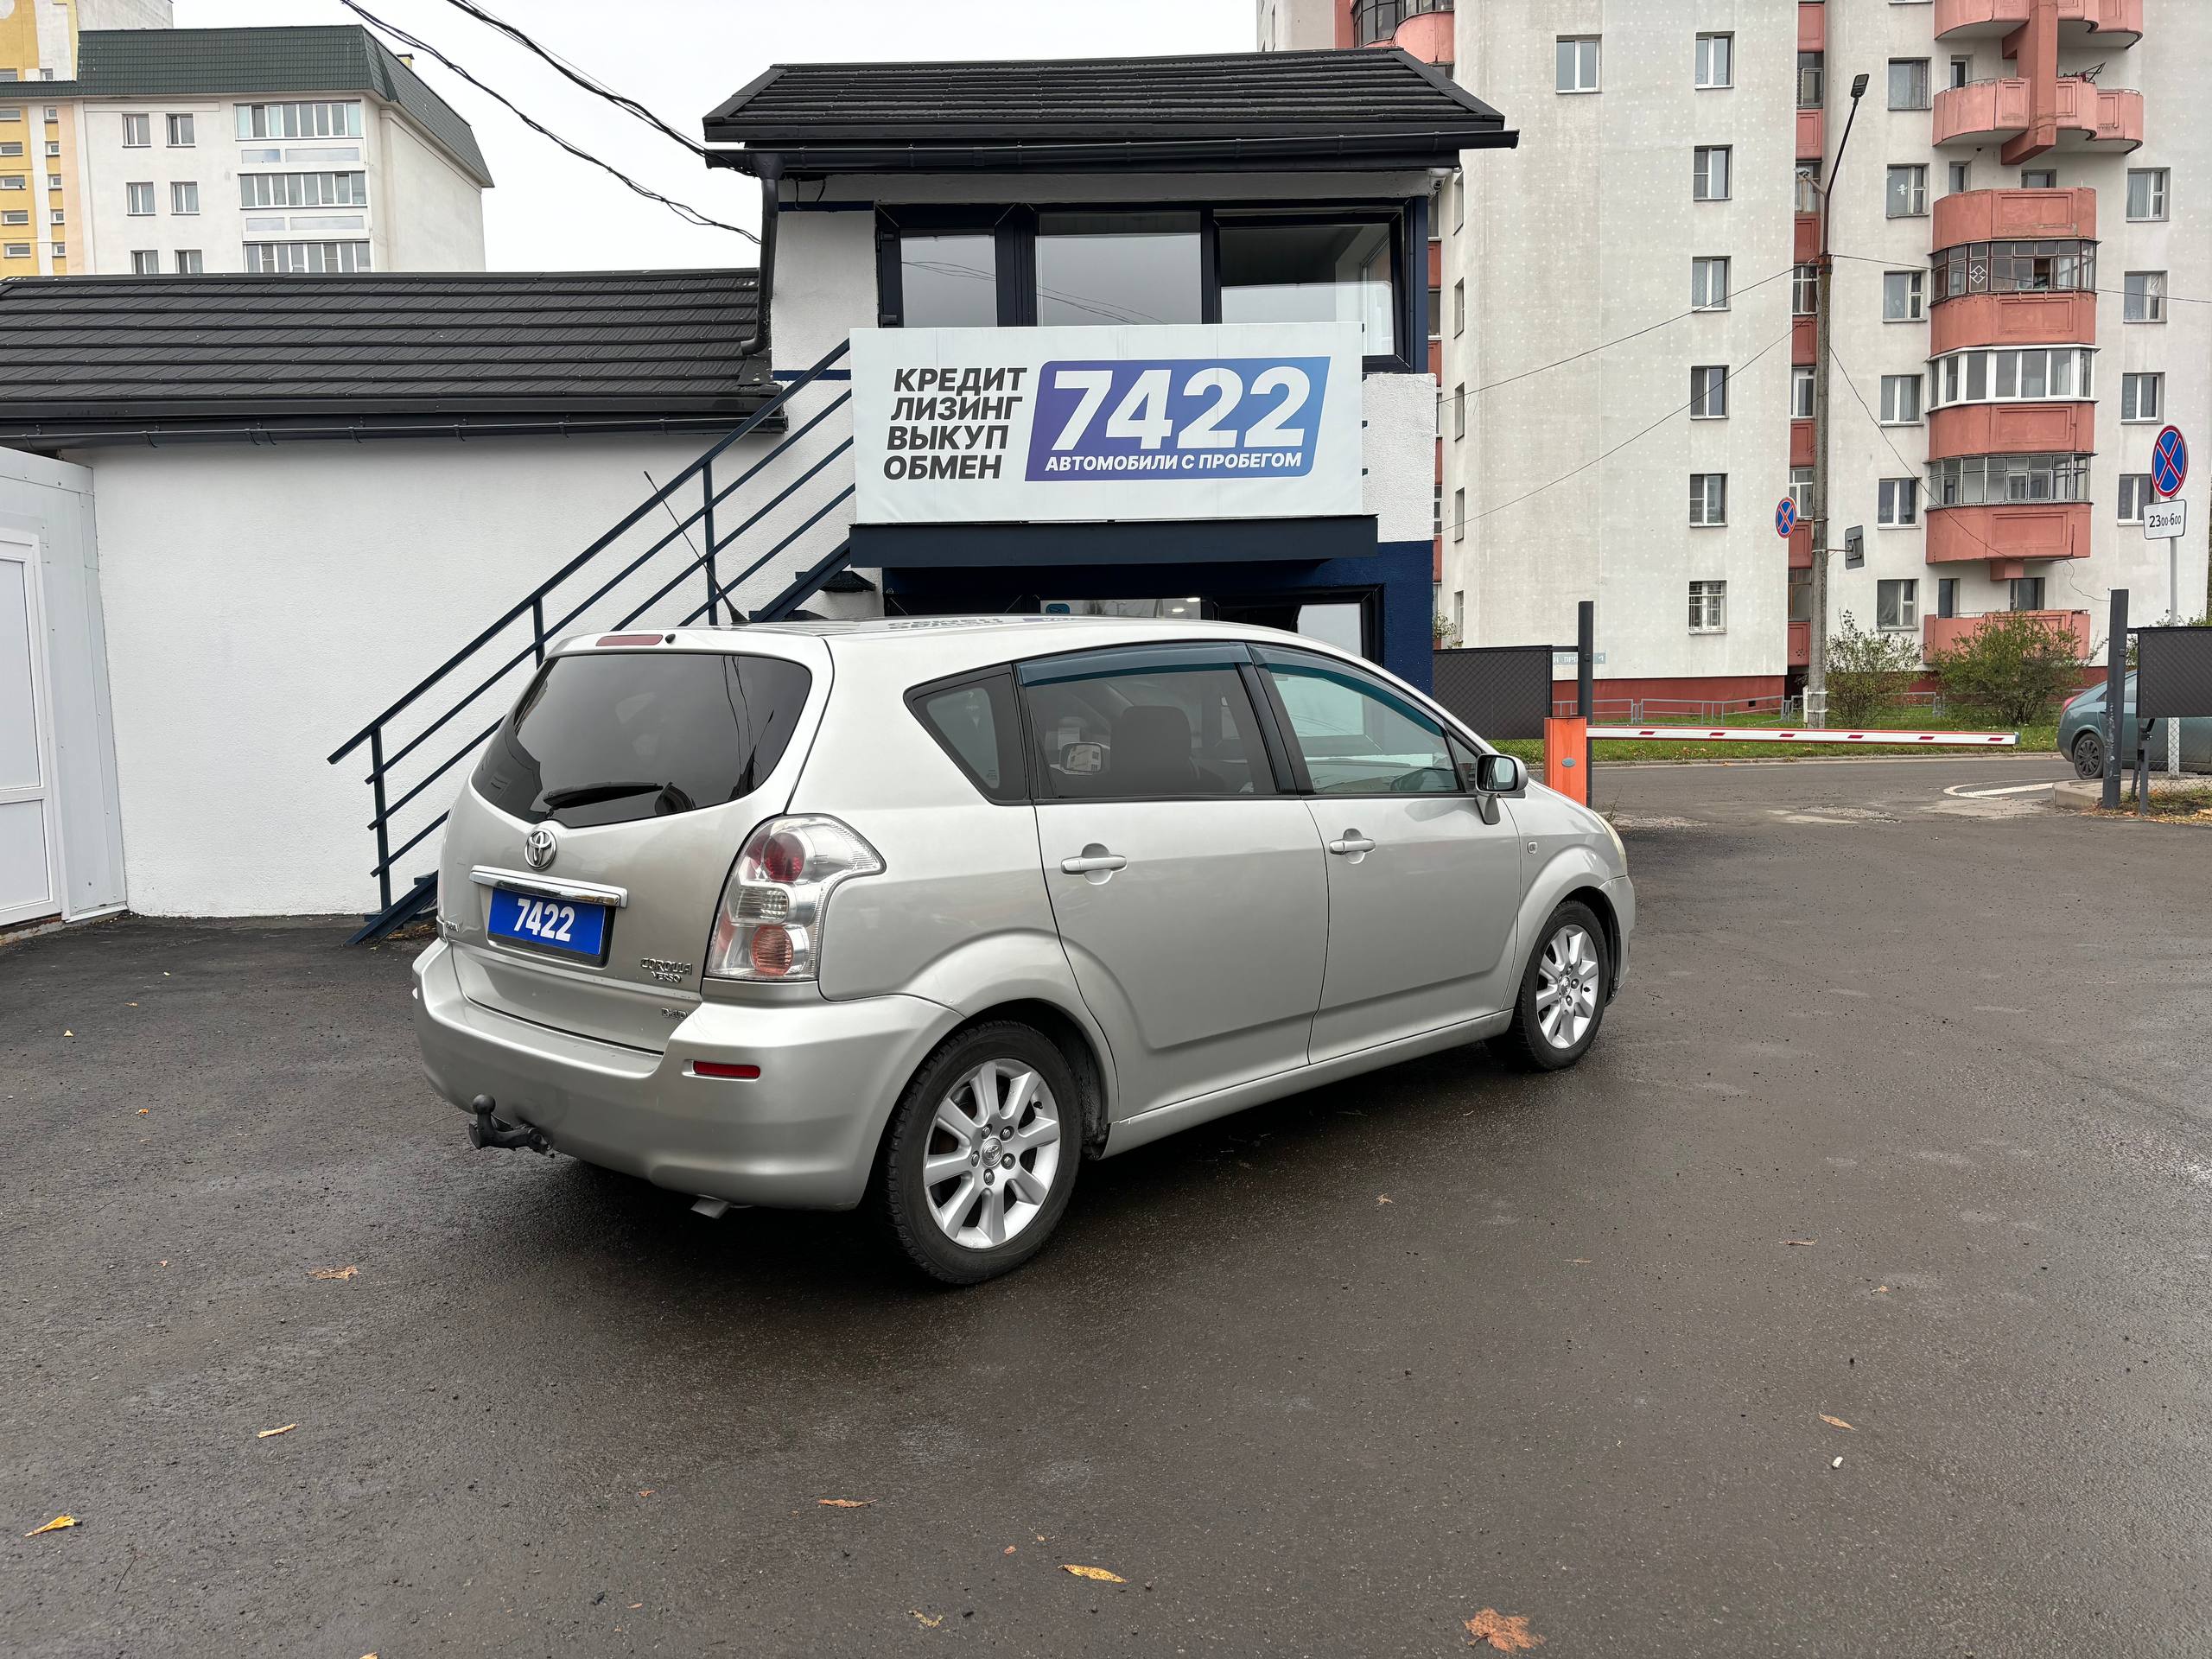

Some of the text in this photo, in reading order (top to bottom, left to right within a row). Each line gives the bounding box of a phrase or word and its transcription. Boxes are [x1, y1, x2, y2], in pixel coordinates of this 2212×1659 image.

[893, 367, 1027, 396] КРЕДИТ
[890, 397, 1023, 421] ЛИЗИНГ
[1052, 366, 1311, 451] 7422
[887, 425, 1009, 450] ВЫКУП
[883, 454, 1002, 480] ОБМЕН
[1045, 452, 1302, 472] АВТОМОБИЛИ С ПРОБЕГОМ
[513, 898, 575, 943] 7422
[640, 957, 693, 976] COROLLA
[651, 970, 682, 983] VERSO
